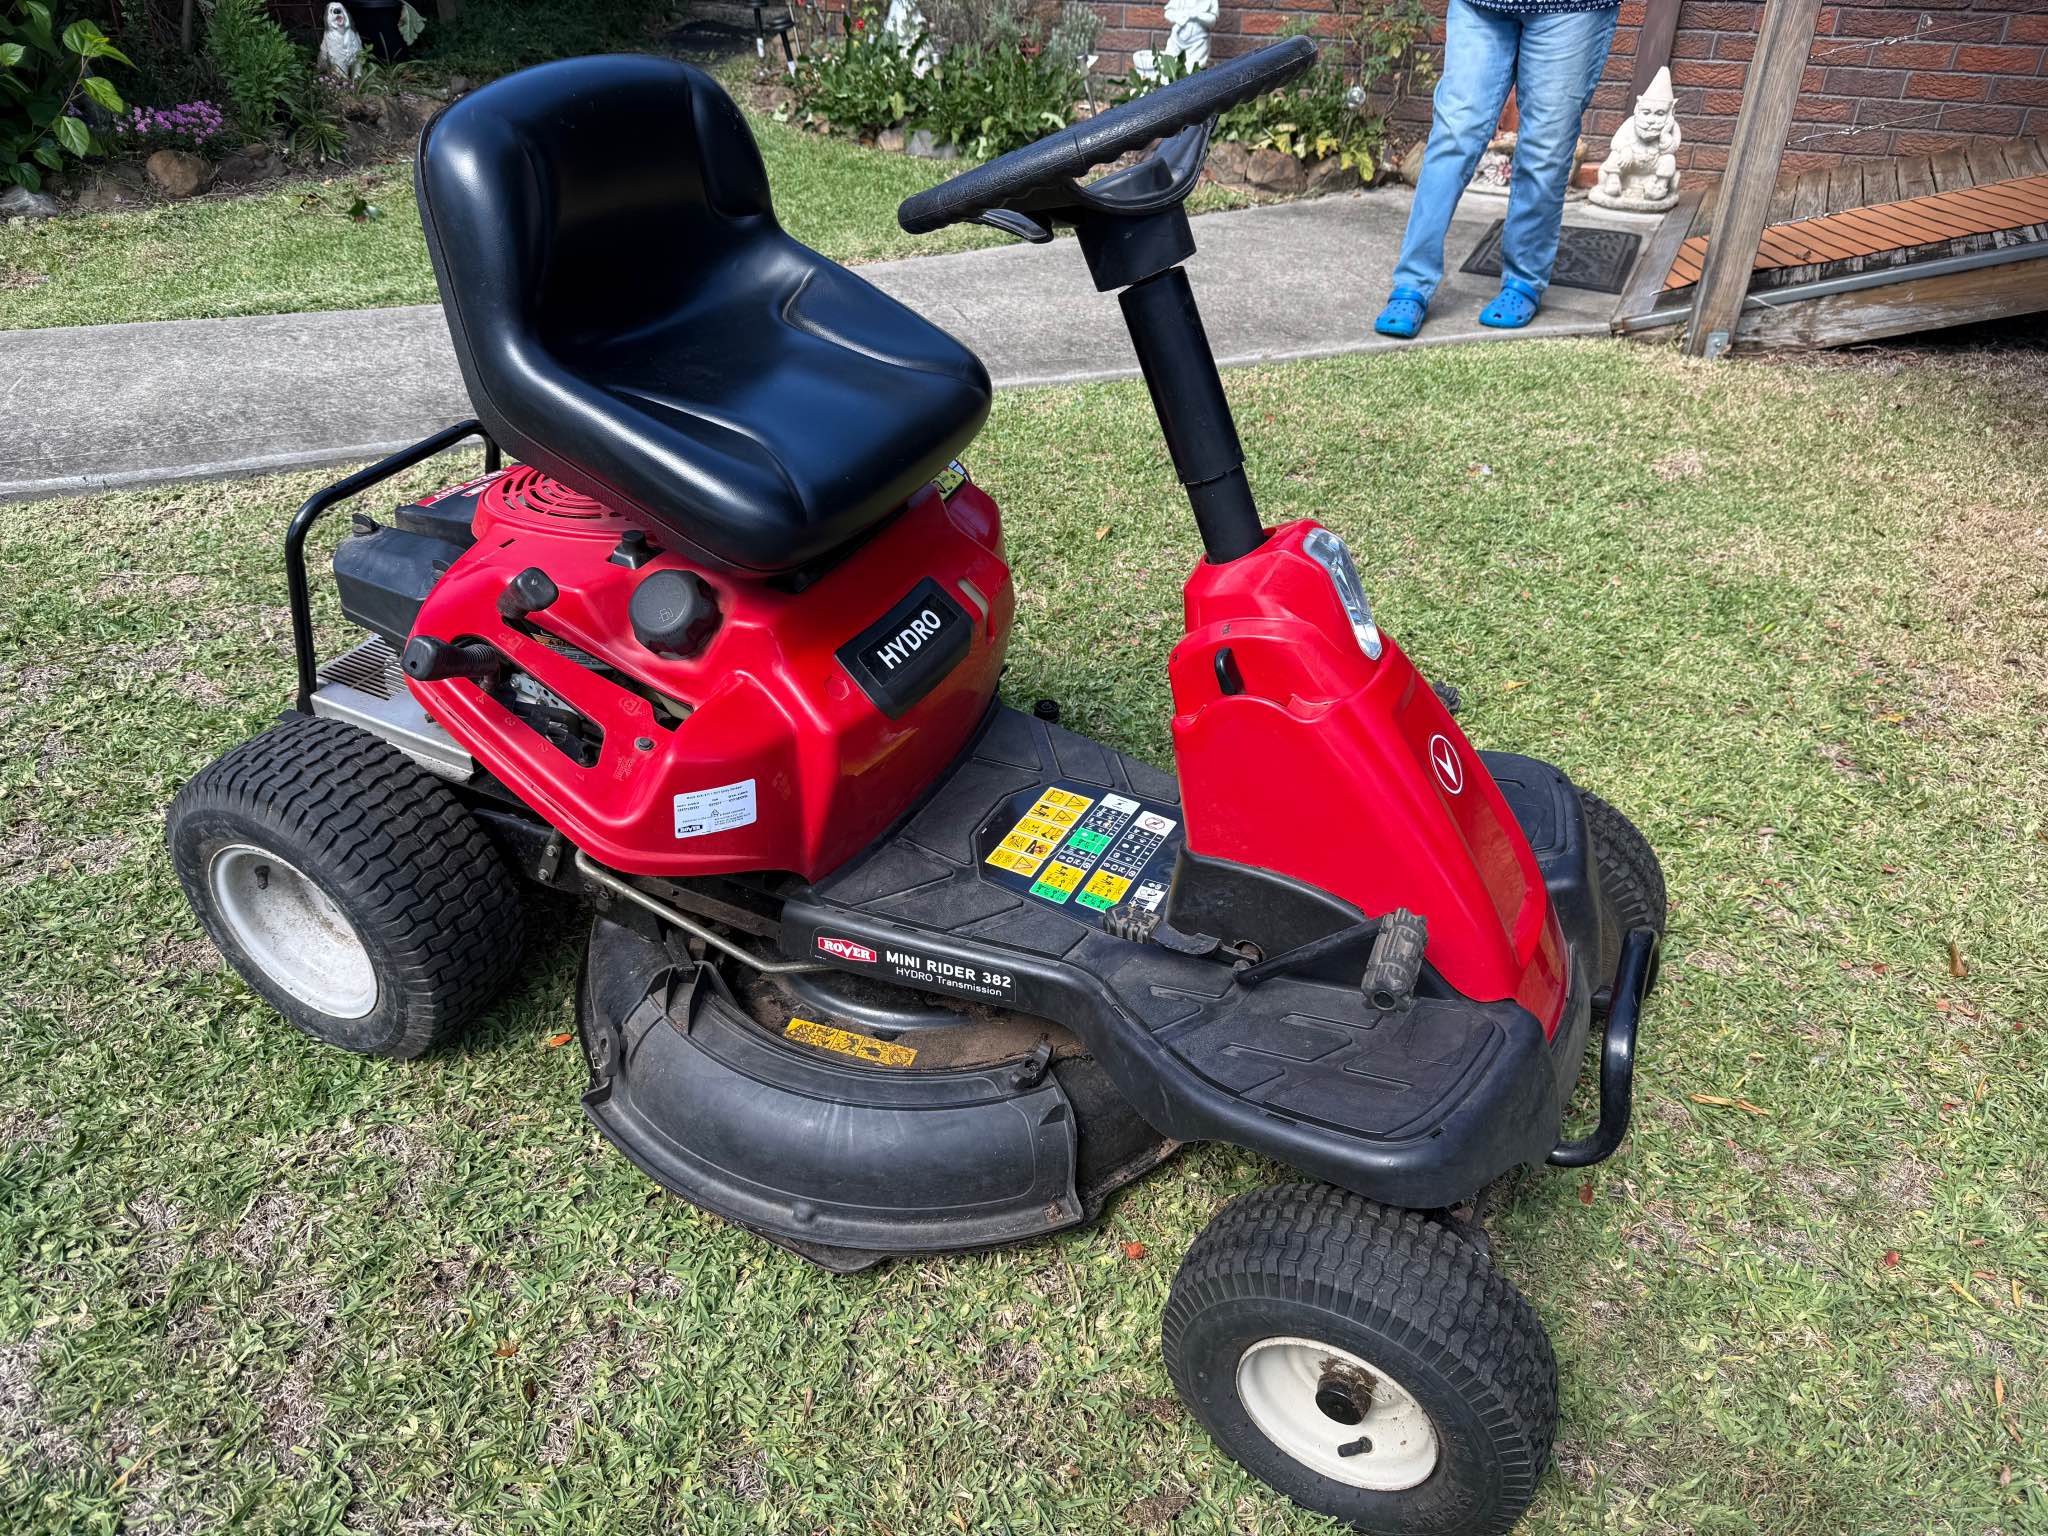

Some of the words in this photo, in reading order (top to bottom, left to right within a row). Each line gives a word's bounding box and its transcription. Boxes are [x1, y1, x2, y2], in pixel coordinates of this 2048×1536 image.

[876, 609, 941, 670] HYDRO
[679, 825, 702, 833] ROVER
[823, 939, 871, 960] ROVER
[886, 950, 920, 968] MINI
[927, 959, 976, 981] RIDER
[982, 972, 1011, 988] 382
[896, 966, 933, 982] HYDRO
[936, 975, 1002, 996] Transmission
